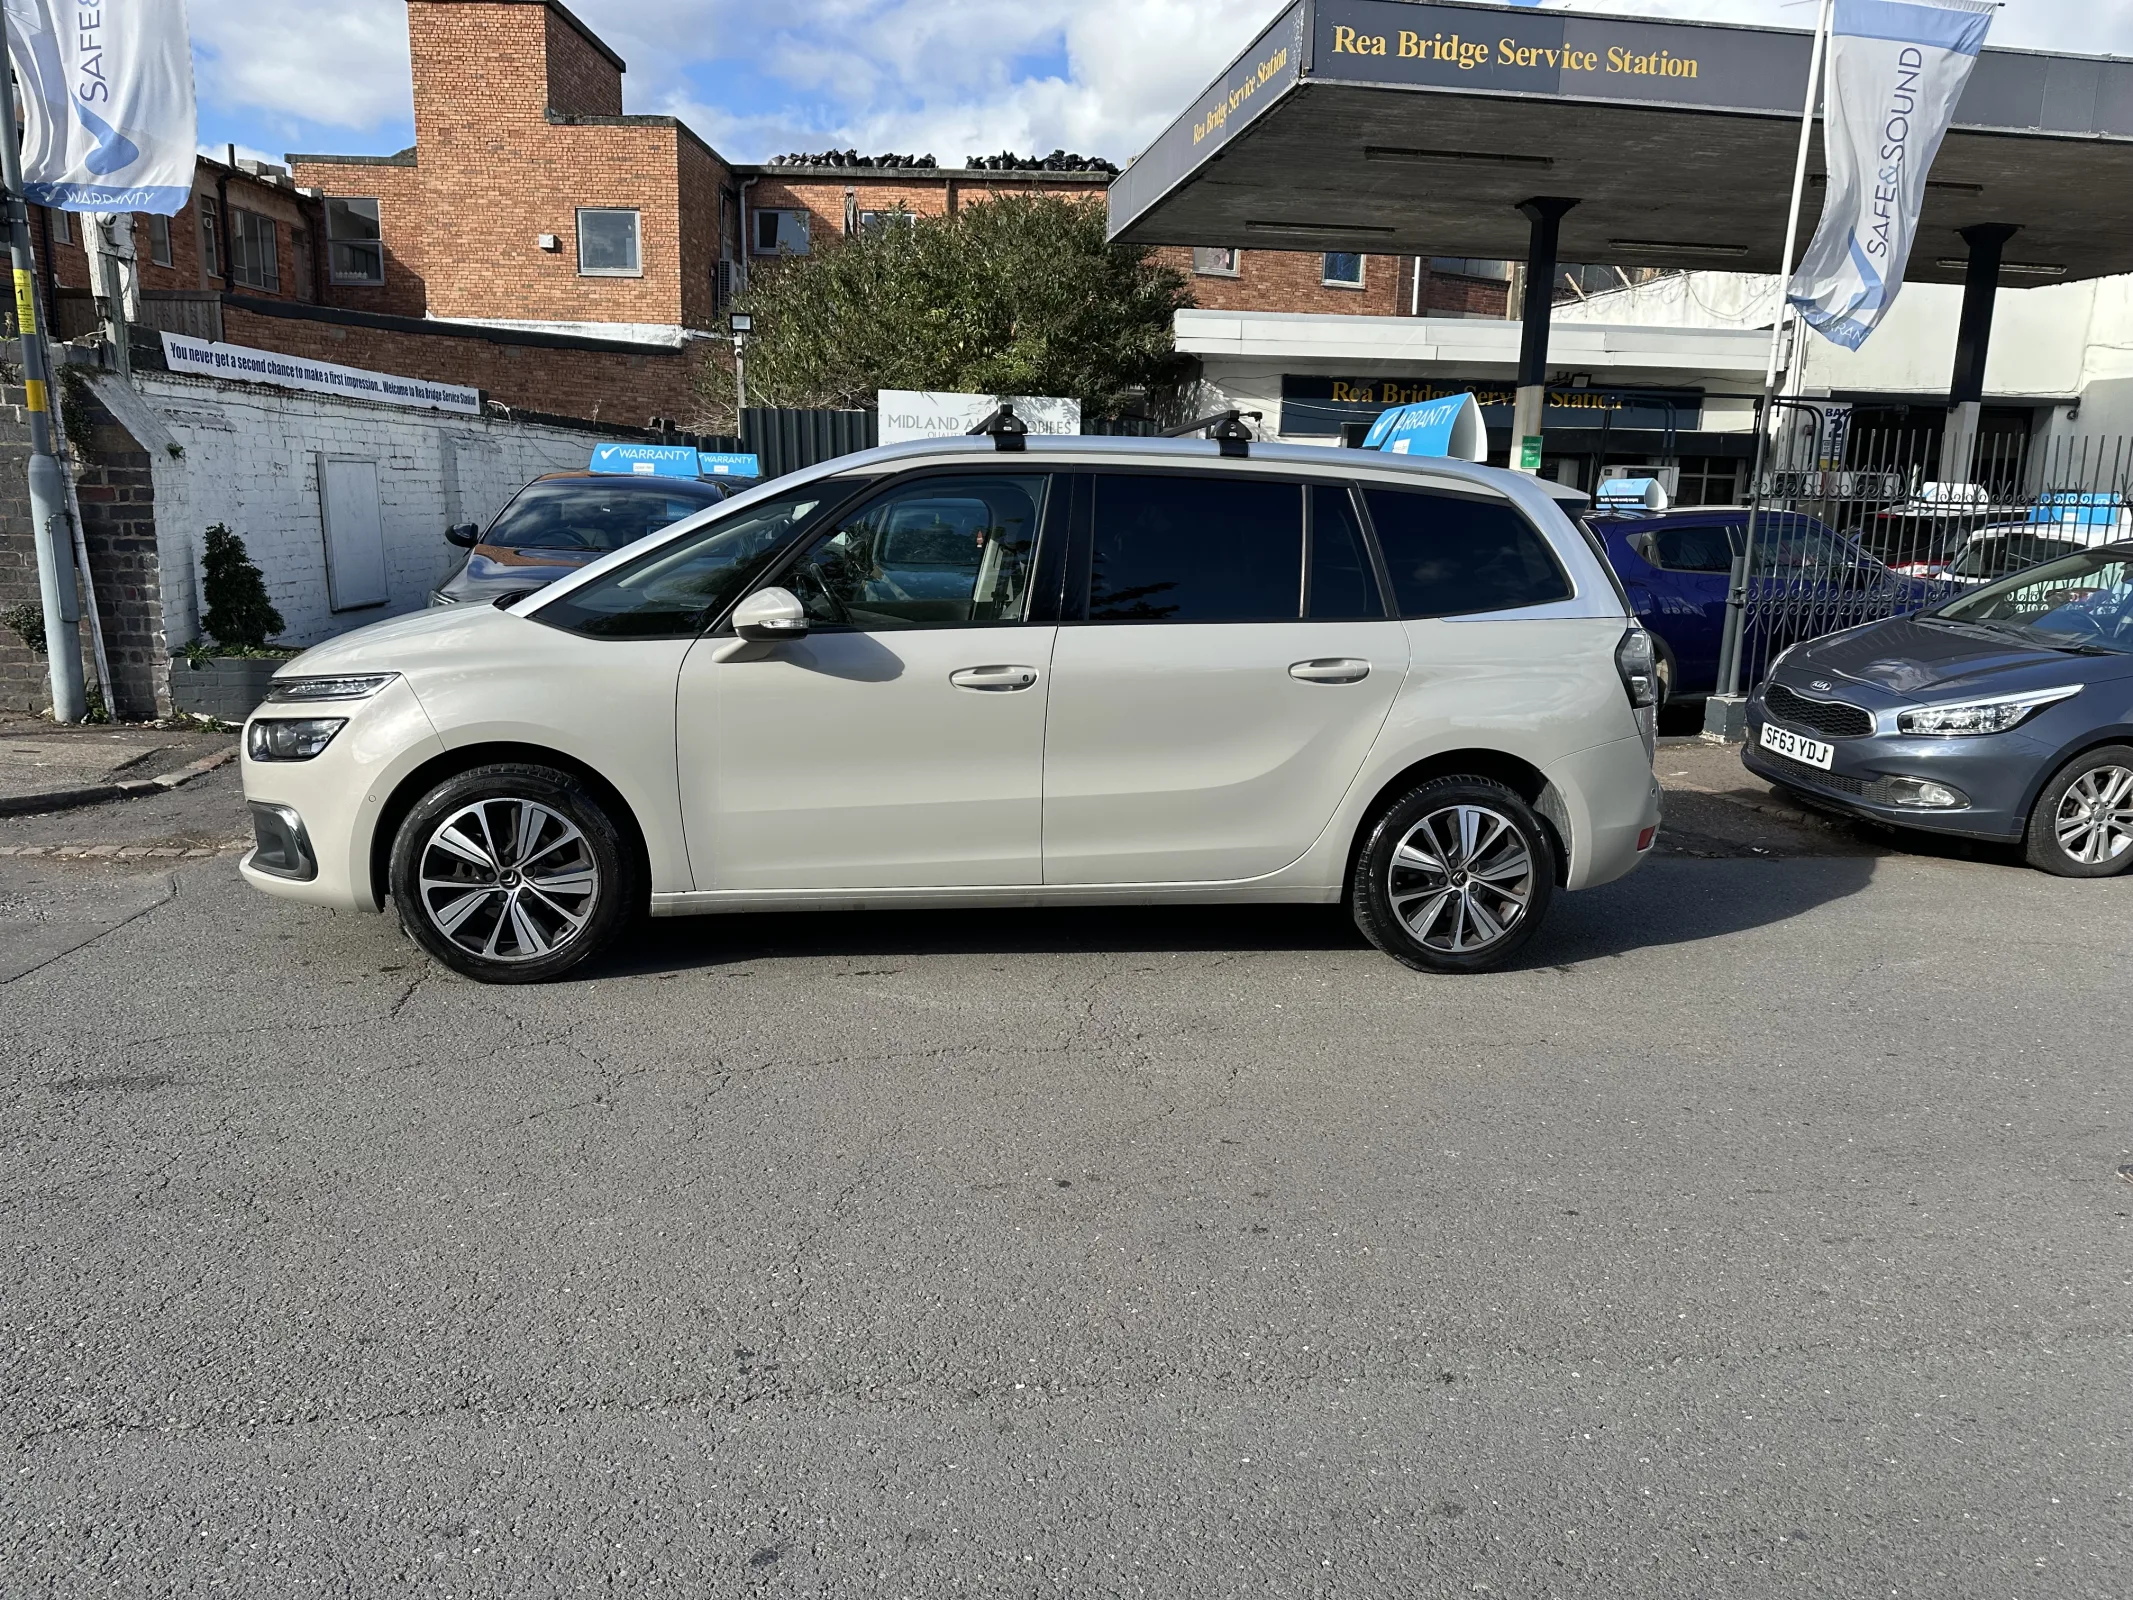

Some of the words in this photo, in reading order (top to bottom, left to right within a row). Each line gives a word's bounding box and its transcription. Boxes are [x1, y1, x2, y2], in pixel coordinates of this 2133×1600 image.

[1332, 25, 1387, 56] Rea
[1396, 30, 1489, 70] Bridge
[1497, 38, 1598, 72] Service
[1606, 46, 1699, 78] Station
[1193, 123, 1205, 146] Rea
[1206, 102, 1228, 134] Bridge
[1228, 75, 1256, 114] Service
[1256, 47, 1287, 89] Station
[17, 288, 24, 301] 1
[170, 341, 188, 360] You
[189, 348, 213, 364] never
[215, 352, 230, 367] get
[230, 355, 236, 368] a
[237, 356, 266, 373] second
[267, 360, 295, 378] chance
[295, 366, 303, 379] to
[304, 368, 323, 382] make
[324, 372, 329, 383] a
[329, 371, 344, 386] first
[382, 380, 409, 396] Welcome
[409, 385, 415, 397] to
[415, 385, 425, 399] Rea
[425, 387, 442, 402] Bridge
[442, 390, 460, 403] Service
[460, 393, 476, 406] Station
[1332, 381, 1373, 403] Rea
[888, 414, 959, 430] MIDLAND
[619, 448, 690, 461] WARRANTY
[703, 455, 753, 464] WARRANTY
[1812, 680, 1828, 689] KIA
[1765, 727, 1795, 753] SF63
[1799, 738, 1827, 763] YDJ
